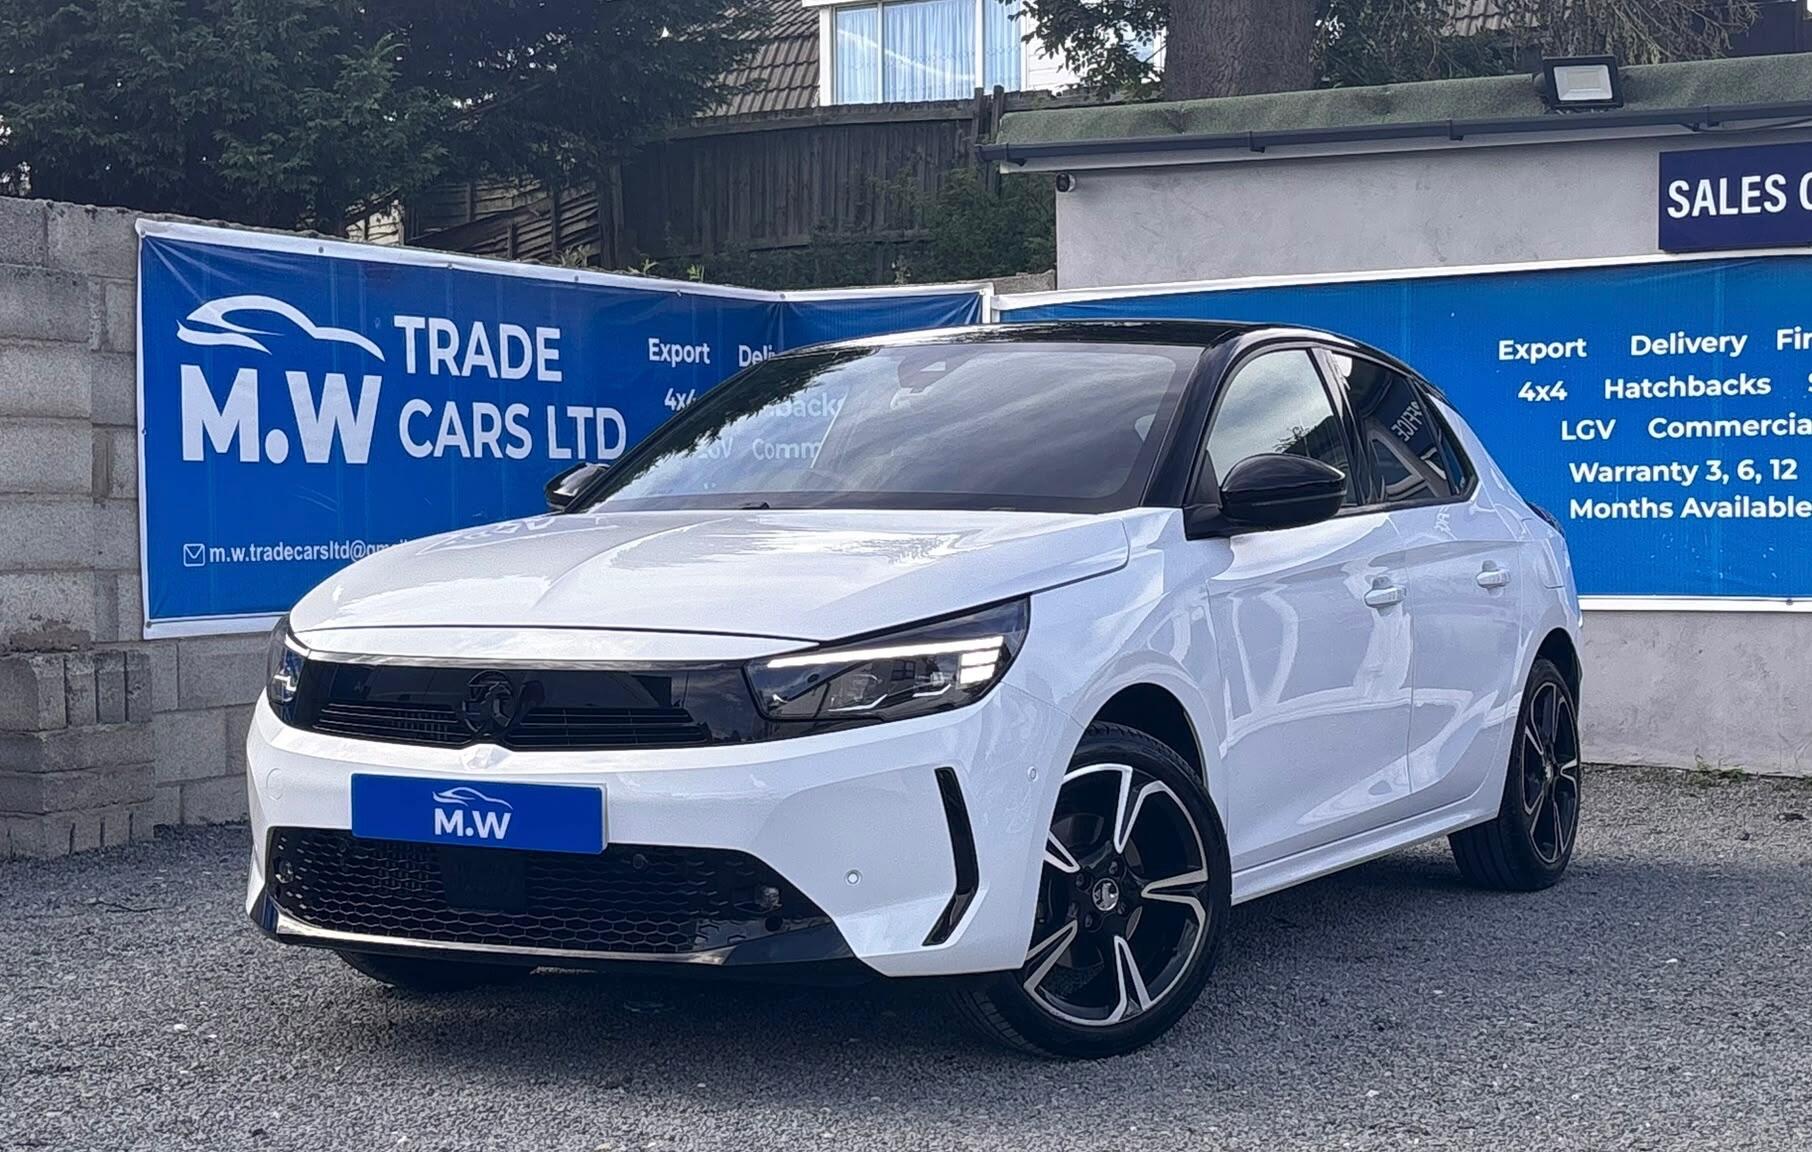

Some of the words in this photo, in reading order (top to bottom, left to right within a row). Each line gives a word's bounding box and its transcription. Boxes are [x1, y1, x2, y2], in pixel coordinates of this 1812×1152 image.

[1667, 173, 1787, 219] SALES
[393, 315, 563, 383] TRADE
[648, 337, 710, 368] Export
[1498, 337, 1588, 364] Export
[1630, 331, 1748, 358] Delivery
[1518, 380, 1568, 402] 4x4
[1604, 373, 1772, 400] Hatchbacks
[180, 364, 382, 465] M.W
[399, 398, 533, 460] CARS
[547, 405, 627, 461] LTD
[1561, 418, 1616, 441] LGV
[1648, 412, 1812, 439] Commercia
[1569, 461, 1700, 487] Warranty
[1705, 459, 1730, 485] 3,
[1737, 459, 1762, 485] 6,
[1769, 458, 1798, 481] 12
[1570, 497, 1674, 520] Months
[1680, 494, 1812, 519] Available
[434, 807, 512, 840] M.W
